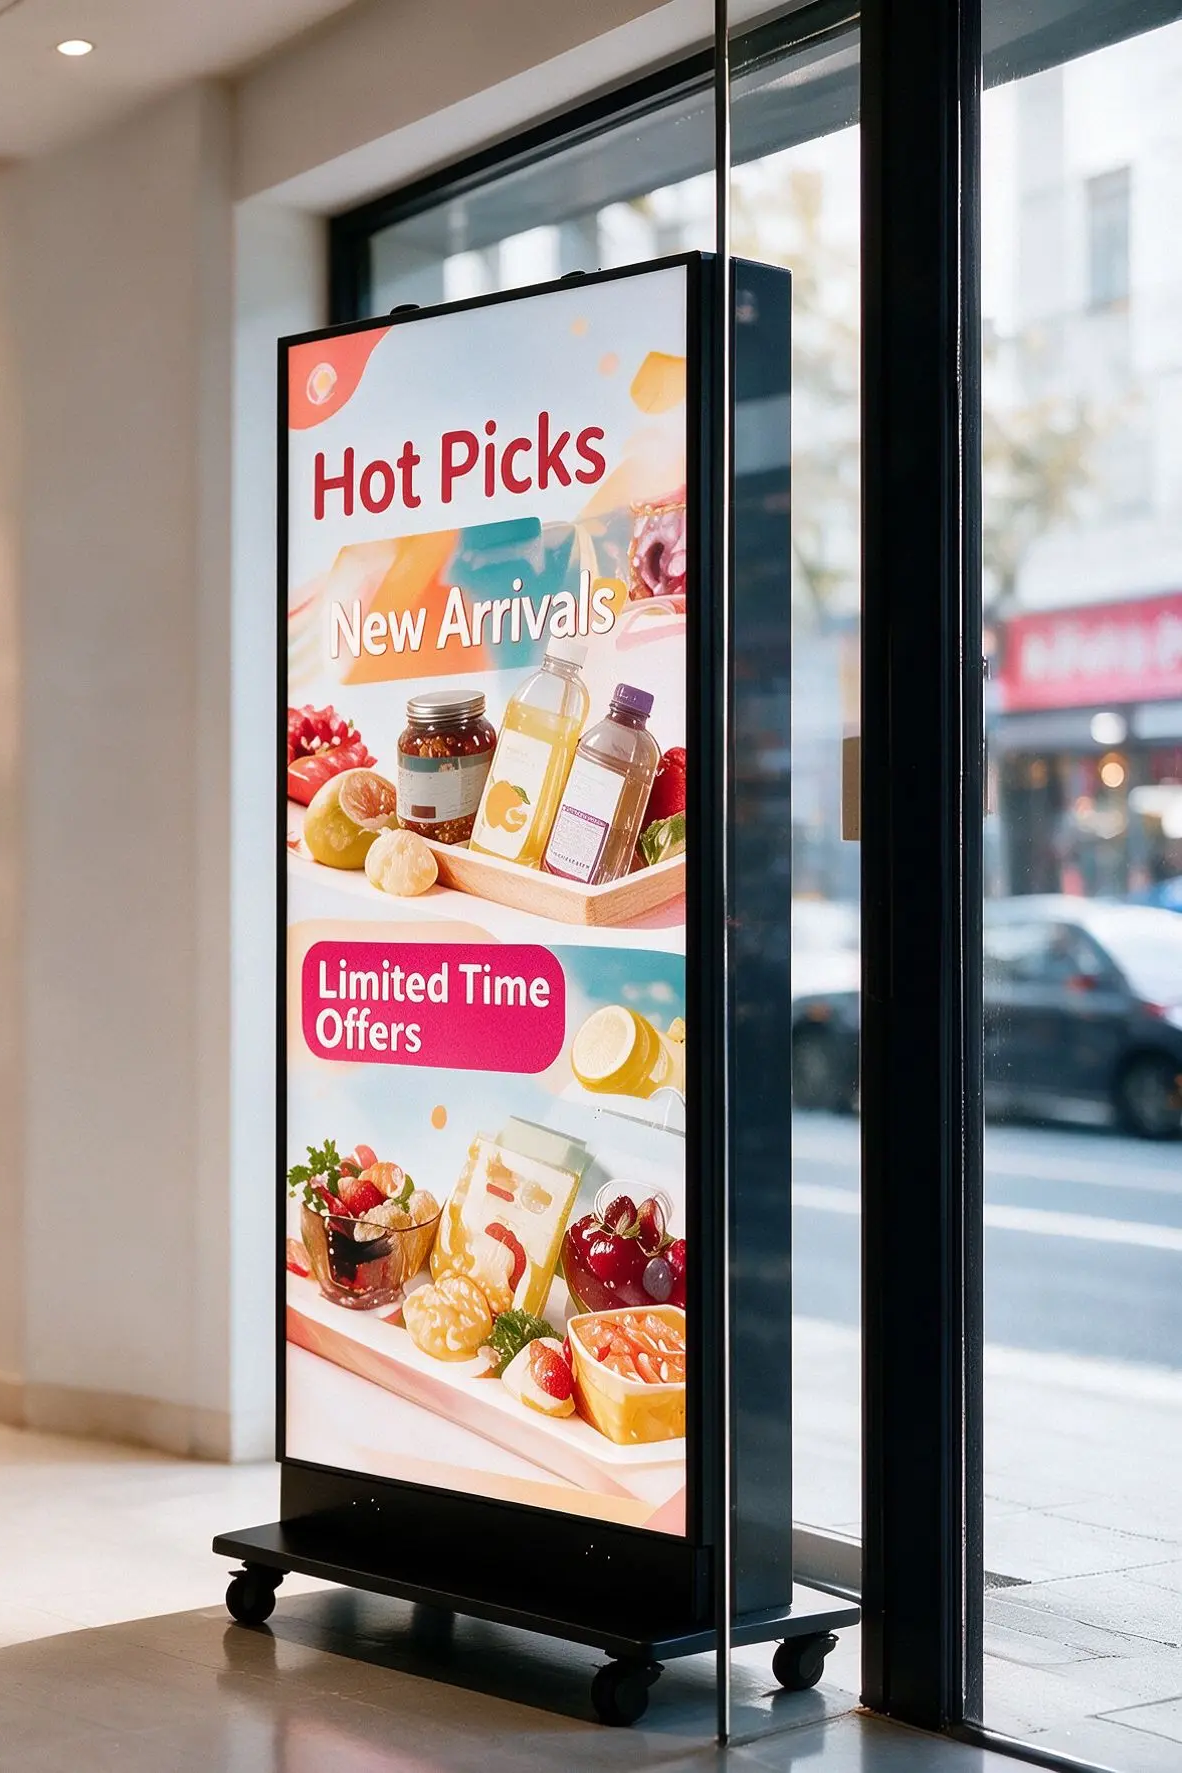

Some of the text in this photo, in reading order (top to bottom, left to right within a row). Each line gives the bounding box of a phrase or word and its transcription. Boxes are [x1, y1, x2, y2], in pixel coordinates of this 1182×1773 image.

[314, 411, 607, 520] Hot Picks
[330, 569, 616, 659] New Arrivals
[318, 959, 550, 1008] Limited Time
[315, 1008, 422, 1053] Offers
